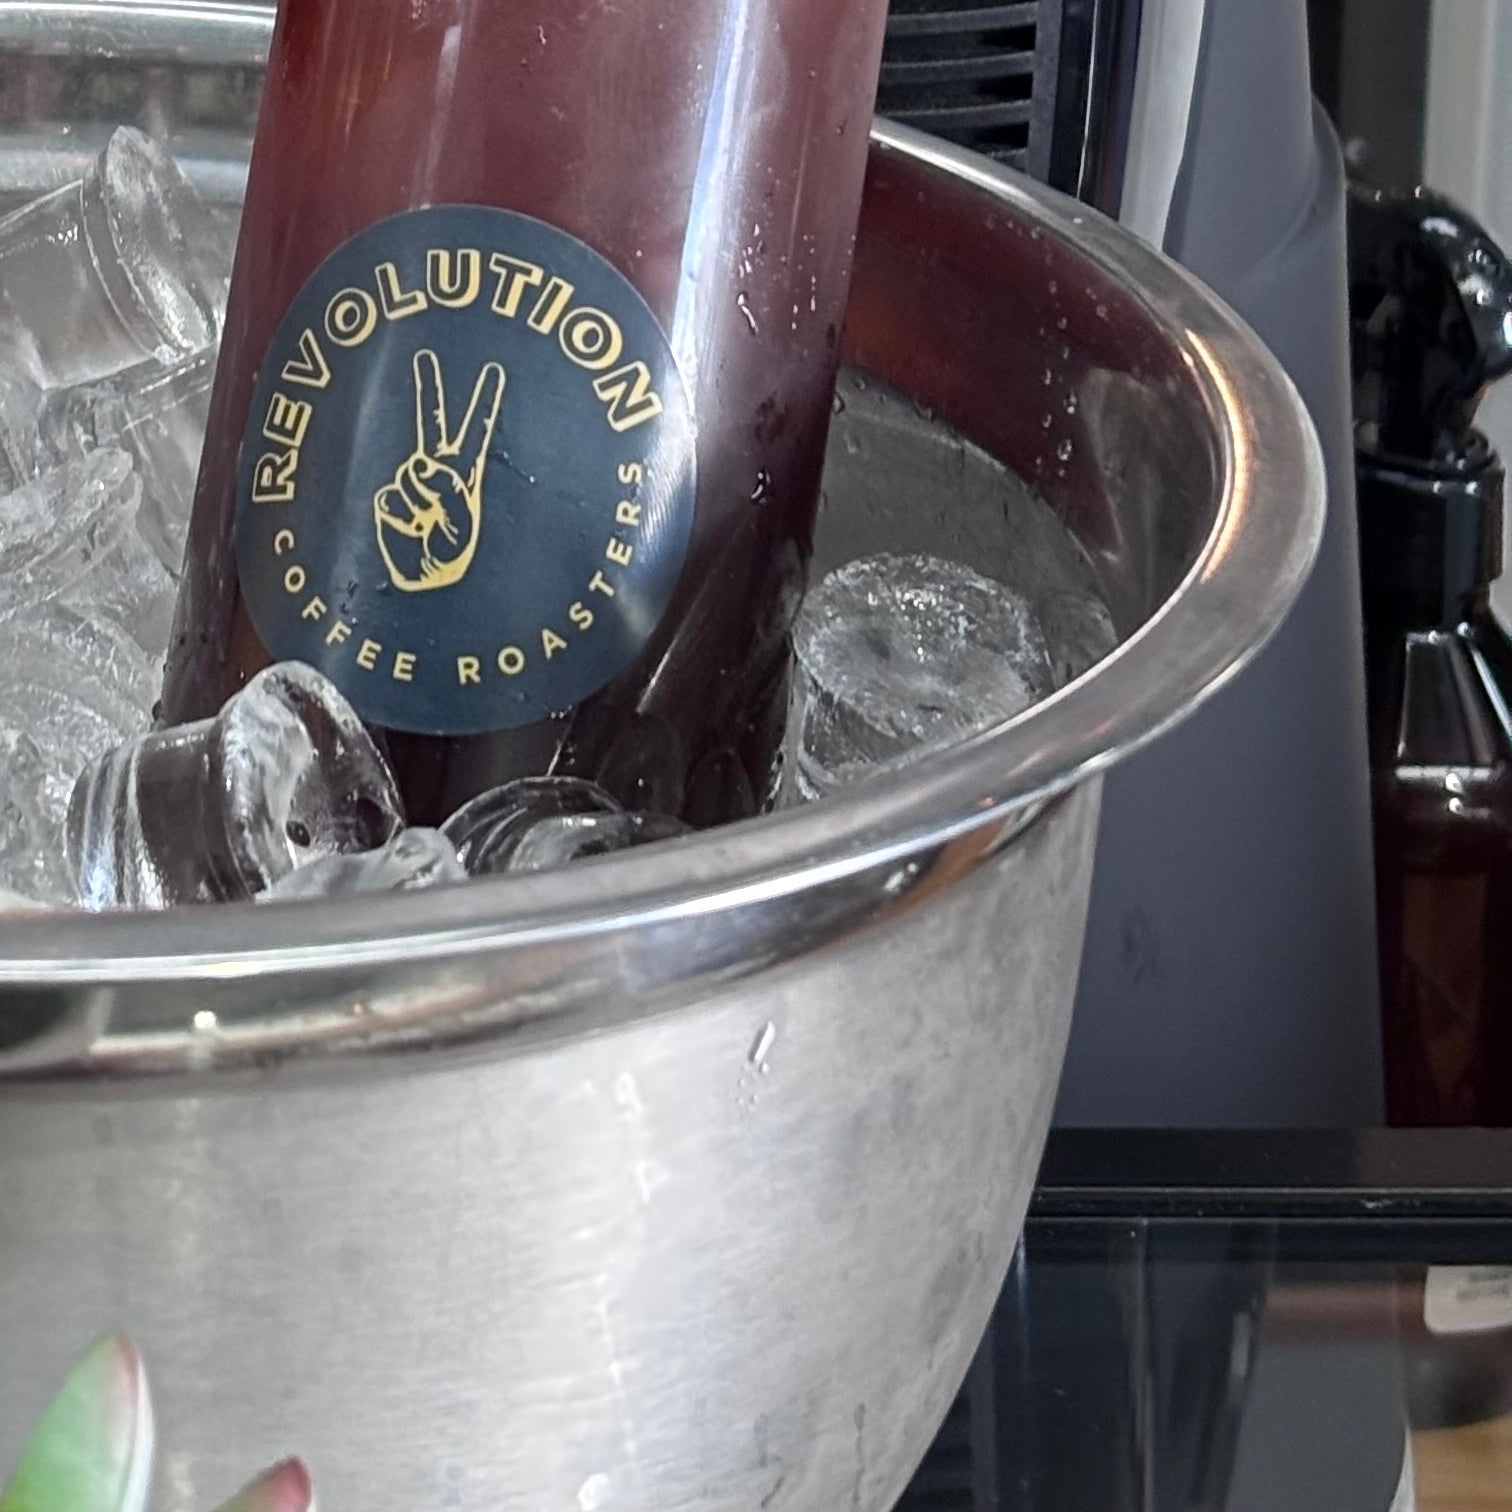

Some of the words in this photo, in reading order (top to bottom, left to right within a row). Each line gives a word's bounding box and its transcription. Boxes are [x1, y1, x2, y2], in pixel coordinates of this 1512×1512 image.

[252, 248, 664, 502] REVOLUTION
[274, 529, 417, 681] COFFEE
[457, 461, 643, 685] ROASTERS
